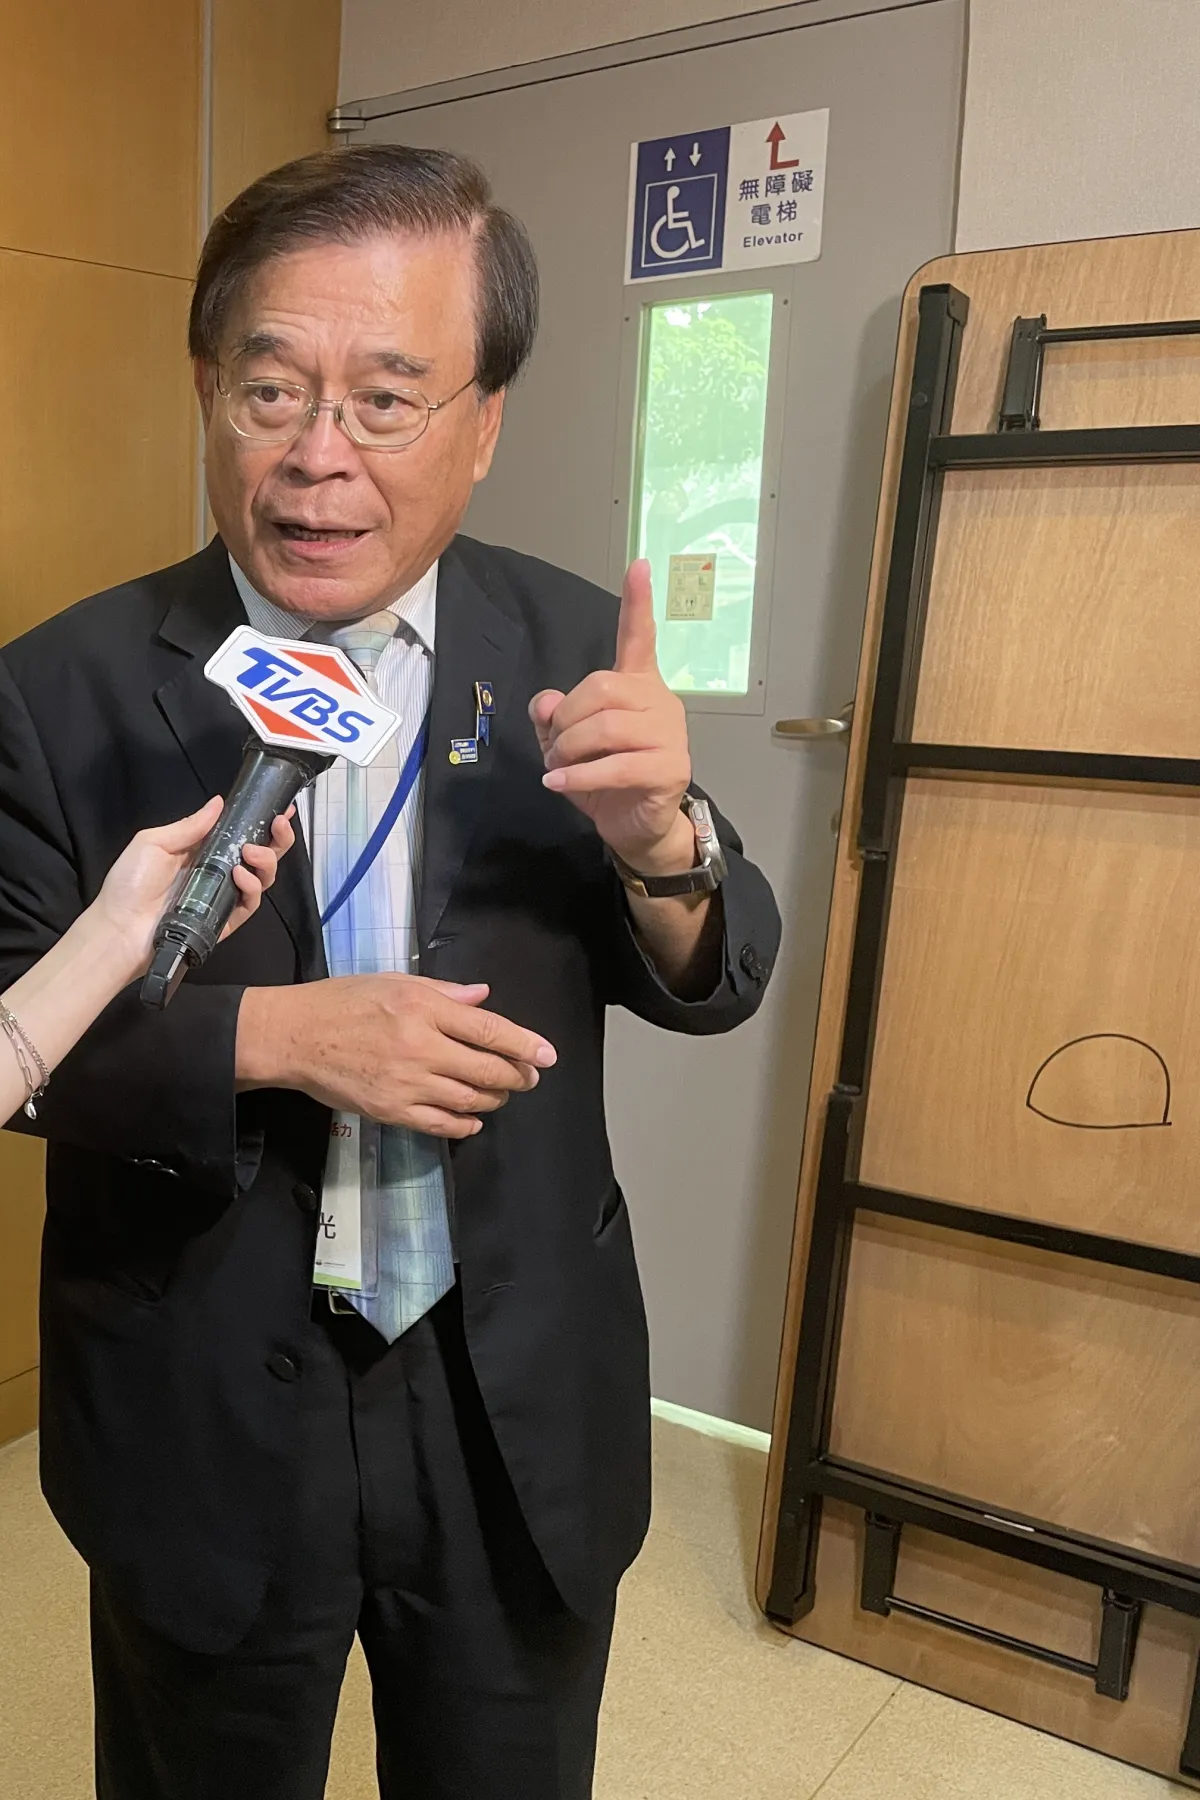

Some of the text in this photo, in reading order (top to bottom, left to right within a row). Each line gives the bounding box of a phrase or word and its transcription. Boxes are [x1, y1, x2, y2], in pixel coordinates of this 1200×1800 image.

[738, 169, 814, 202] 無障礙
[750, 199, 798, 226] 電梯
[743, 231, 805, 248] Elevator
[236, 646, 376, 744] TVBS
